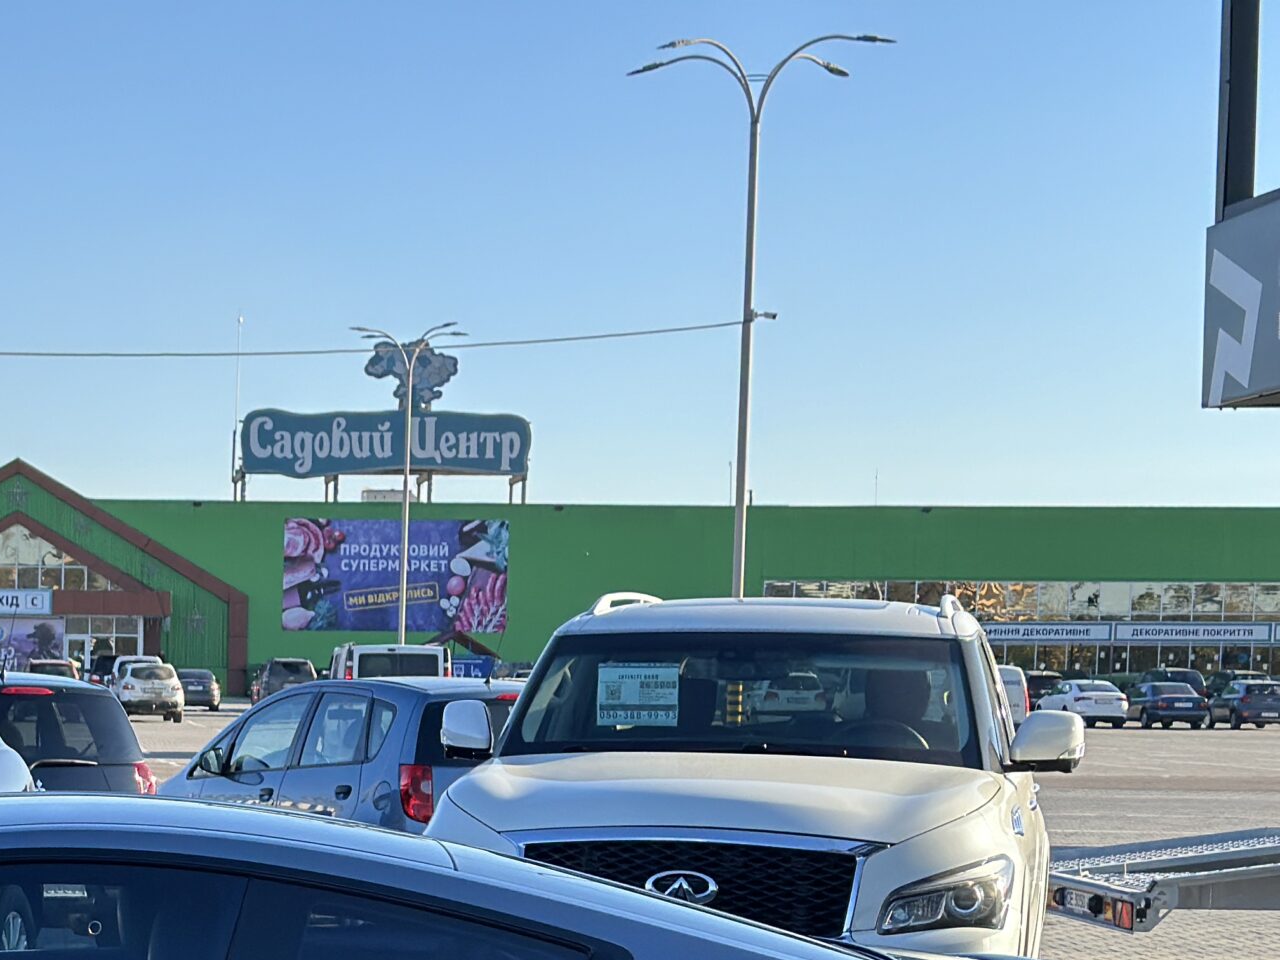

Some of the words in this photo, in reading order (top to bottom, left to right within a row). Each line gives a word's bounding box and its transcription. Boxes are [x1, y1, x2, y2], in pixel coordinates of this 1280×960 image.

[249, 416, 393, 473] Садовий
[410, 416, 521, 471] Центр
[340, 541, 449, 558] ПРОДУКОВИЙ
[341, 559, 448, 572] СУПЕРМРКЕТ
[349, 595, 366, 606] МИ
[367, 588, 434, 603] ВІДКРЛИСЬ
[1022, 627, 1091, 637] ДЕКОРАТИВНЕ
[1131, 627, 1200, 638] ДЕКОРАТИВНЕ
[1203, 627, 1254, 637] ПОКРИТТЯ
